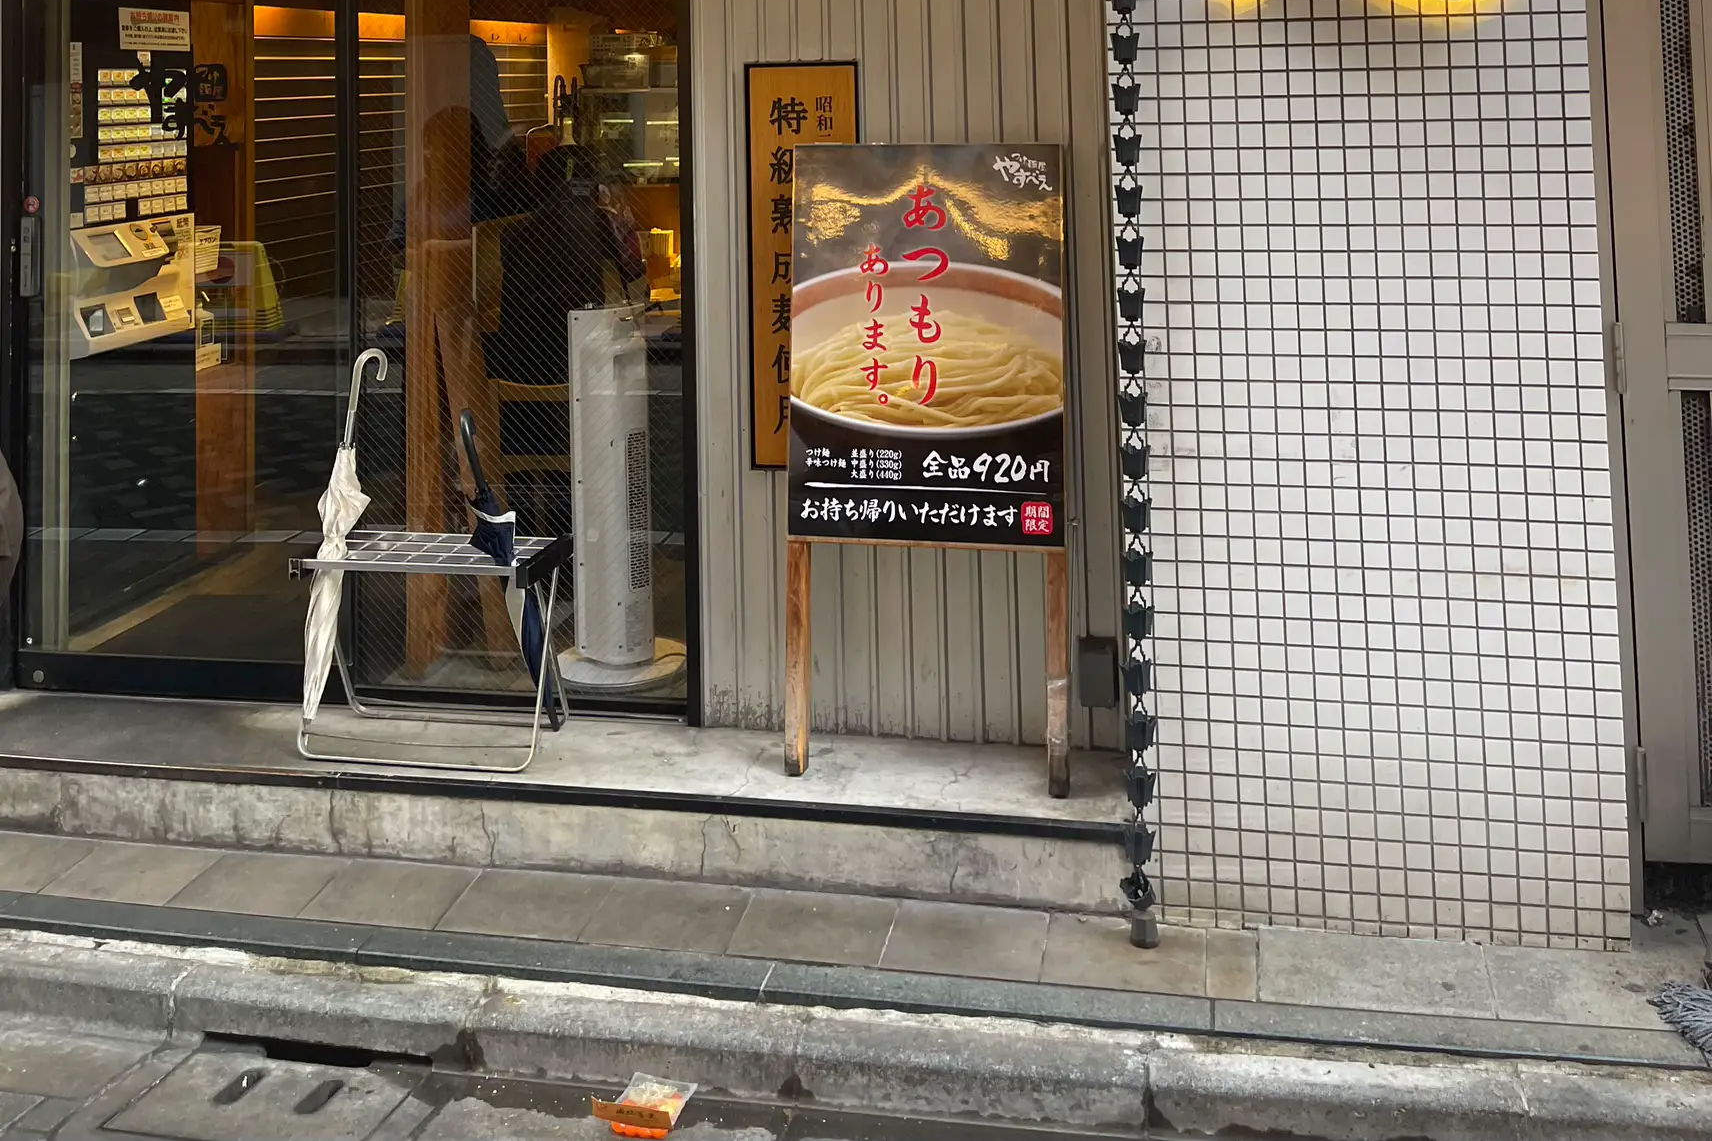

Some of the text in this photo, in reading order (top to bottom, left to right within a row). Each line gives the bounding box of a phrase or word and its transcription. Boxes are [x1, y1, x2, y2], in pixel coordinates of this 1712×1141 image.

[815, 95, 833, 138] 昭和
[993, 155, 1053, 191] やすべえ
[902, 184, 949, 406] あつもり
[860, 243, 889, 406] あります。
[805, 448, 831, 458] つけ麺
[922, 450, 1050, 483] 全品920円
[800, 497, 1018, 527] お持ち帰りいただけます
[1024, 505, 1050, 518] 期間
[1024, 518, 1050, 533] 限定
